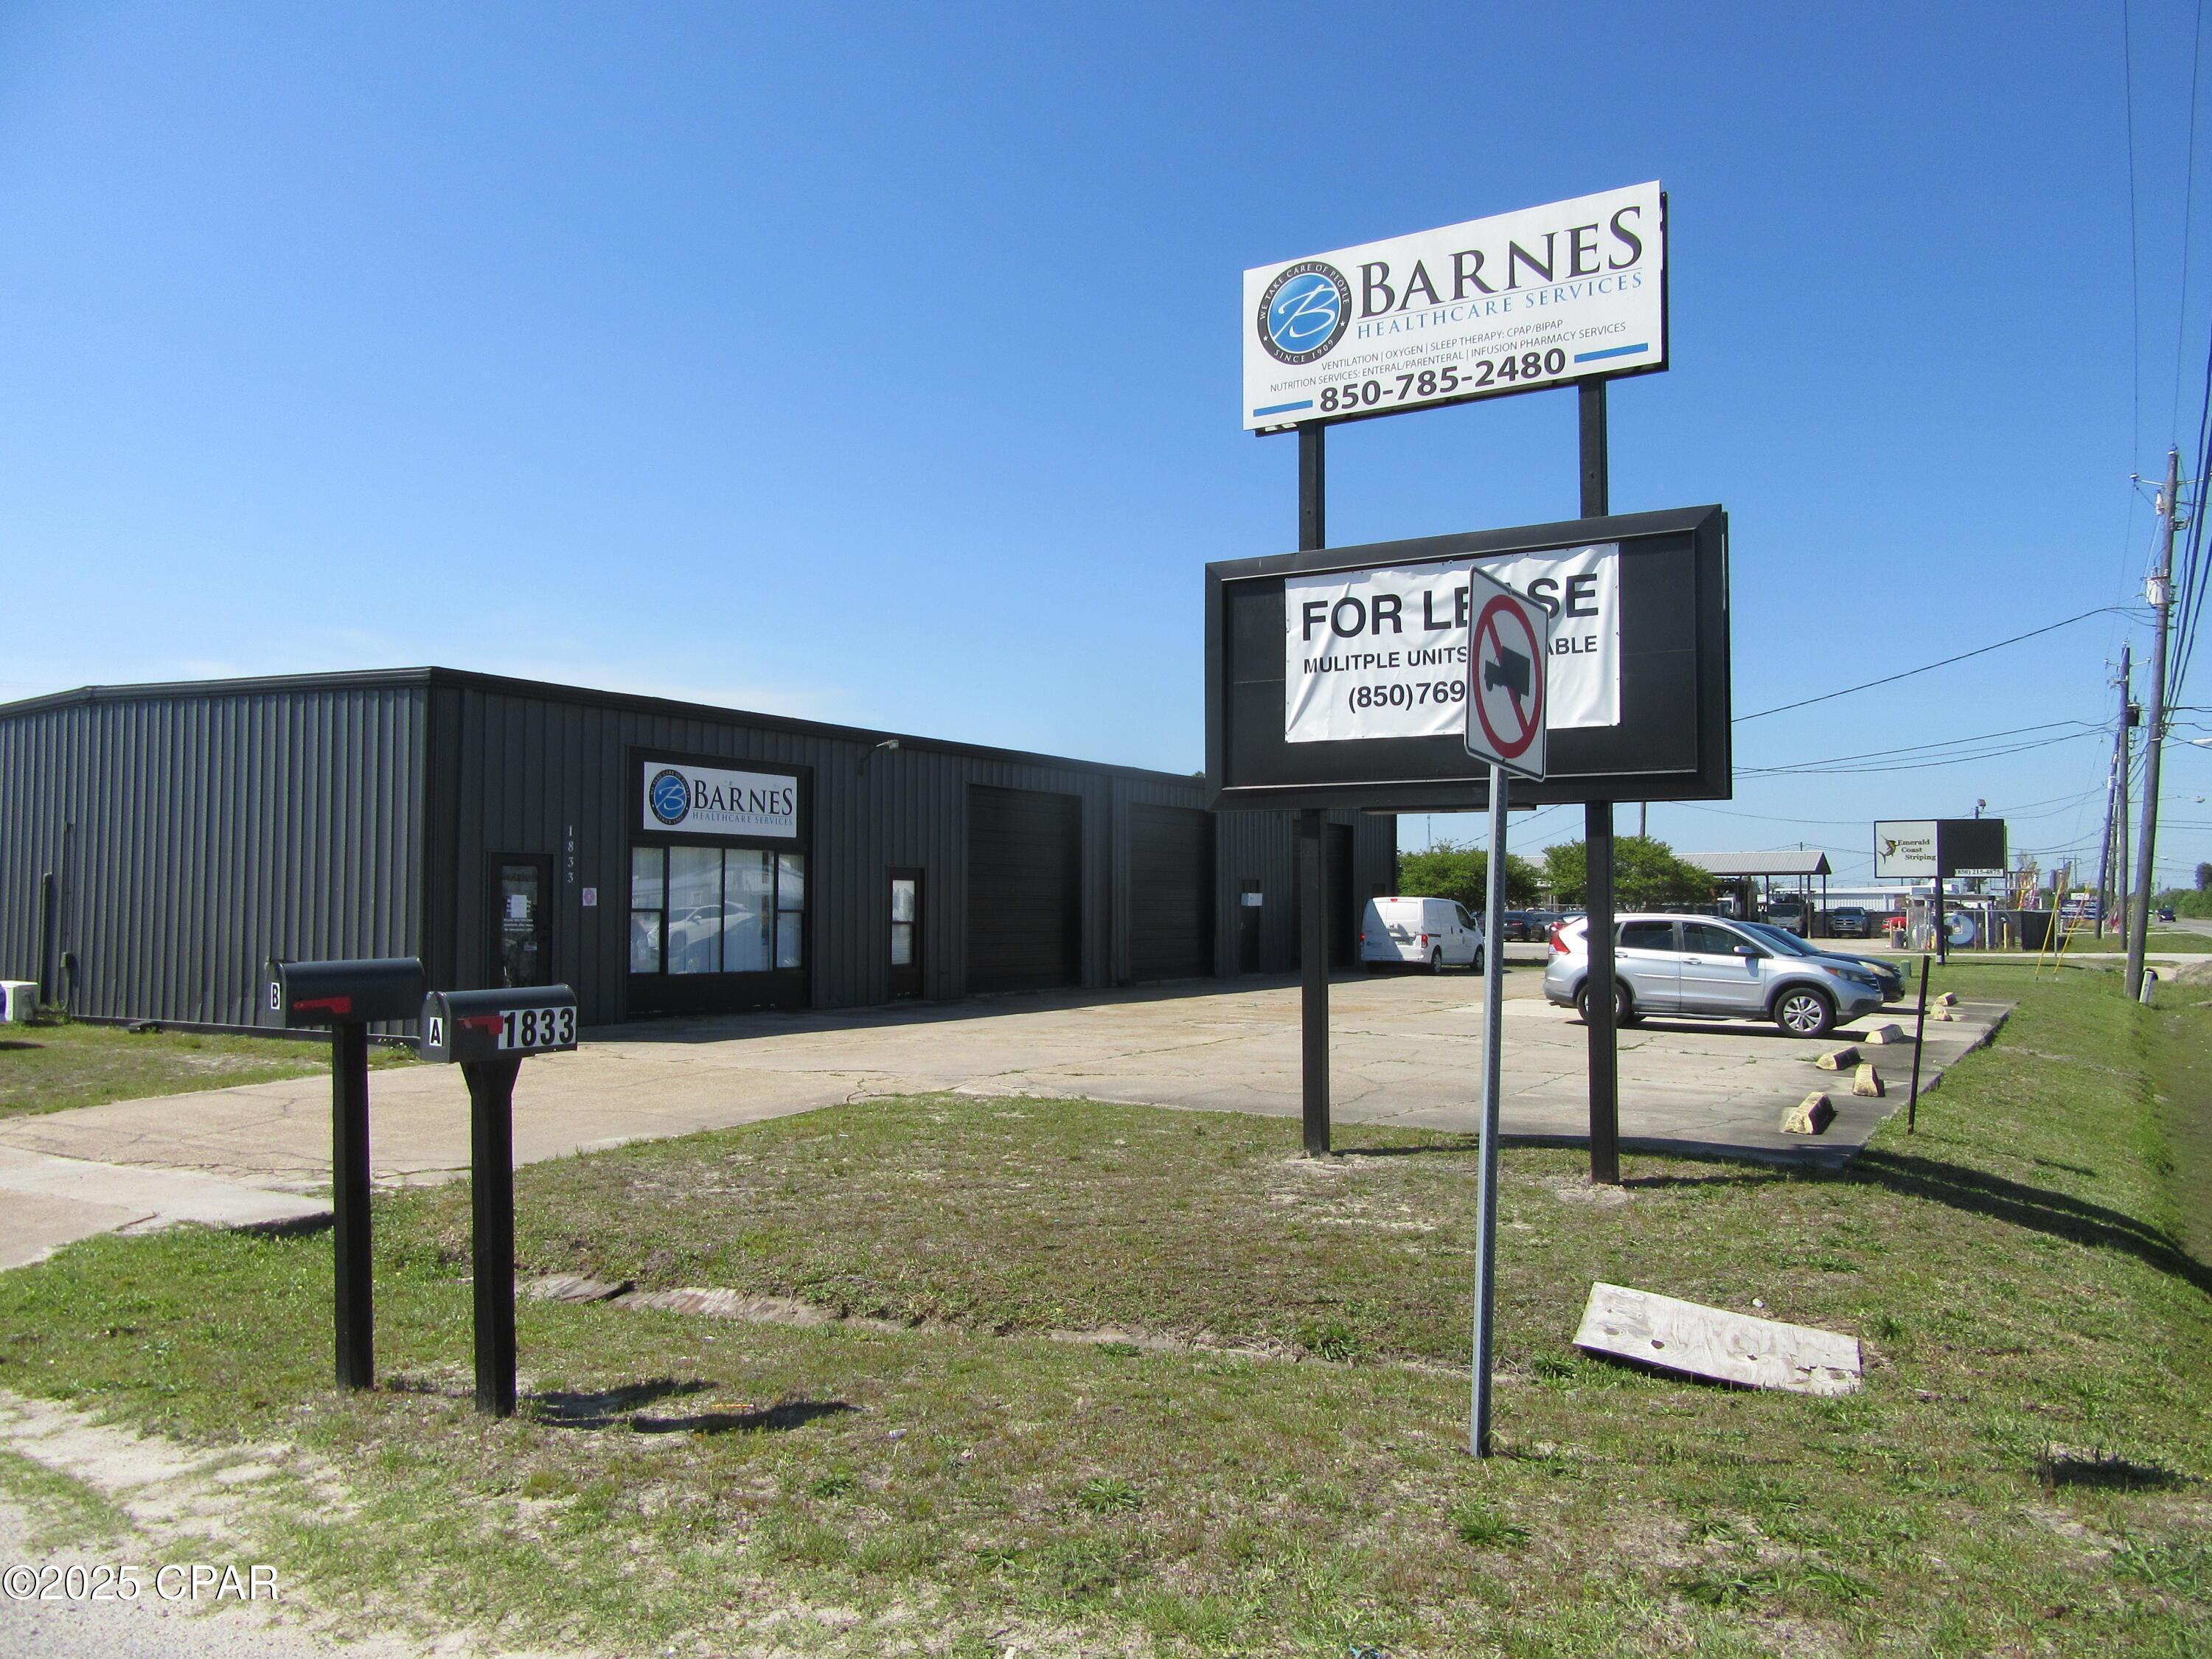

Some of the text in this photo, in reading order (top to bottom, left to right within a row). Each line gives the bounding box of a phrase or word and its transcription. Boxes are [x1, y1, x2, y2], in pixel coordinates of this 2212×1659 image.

[1357, 206, 1643, 319] BARNES
[1259, 264, 1350, 320] WE TAKE CARE OF PEOPLE
[1357, 272, 1643, 340] HEALTHCARE SERVICES
[1270, 321, 1626, 392] NUTRITION SERVICES: ENTERAL/PARENTERAL INFUSION PHARMACY SERVICES
[1273, 339, 1334, 363] SINCE 1909
[1321, 319, 1563, 370] VENTILATION OXYGEN SLEEP THERAPY: CPAP/BIPAP
[1320, 348, 1566, 412] 850-785-2480
[1303, 594, 1402, 641] FOR
[1304, 646, 1467, 675] MULITPLE UNITS
[692, 779, 793, 815] BARNES
[692, 811, 751, 824] HEALTHCARE
[755, 816, 793, 827] SERVICES
[271, 984, 279, 1008] B
[430, 1019, 441, 1045] A
[503, 1009, 574, 1048] 1833
